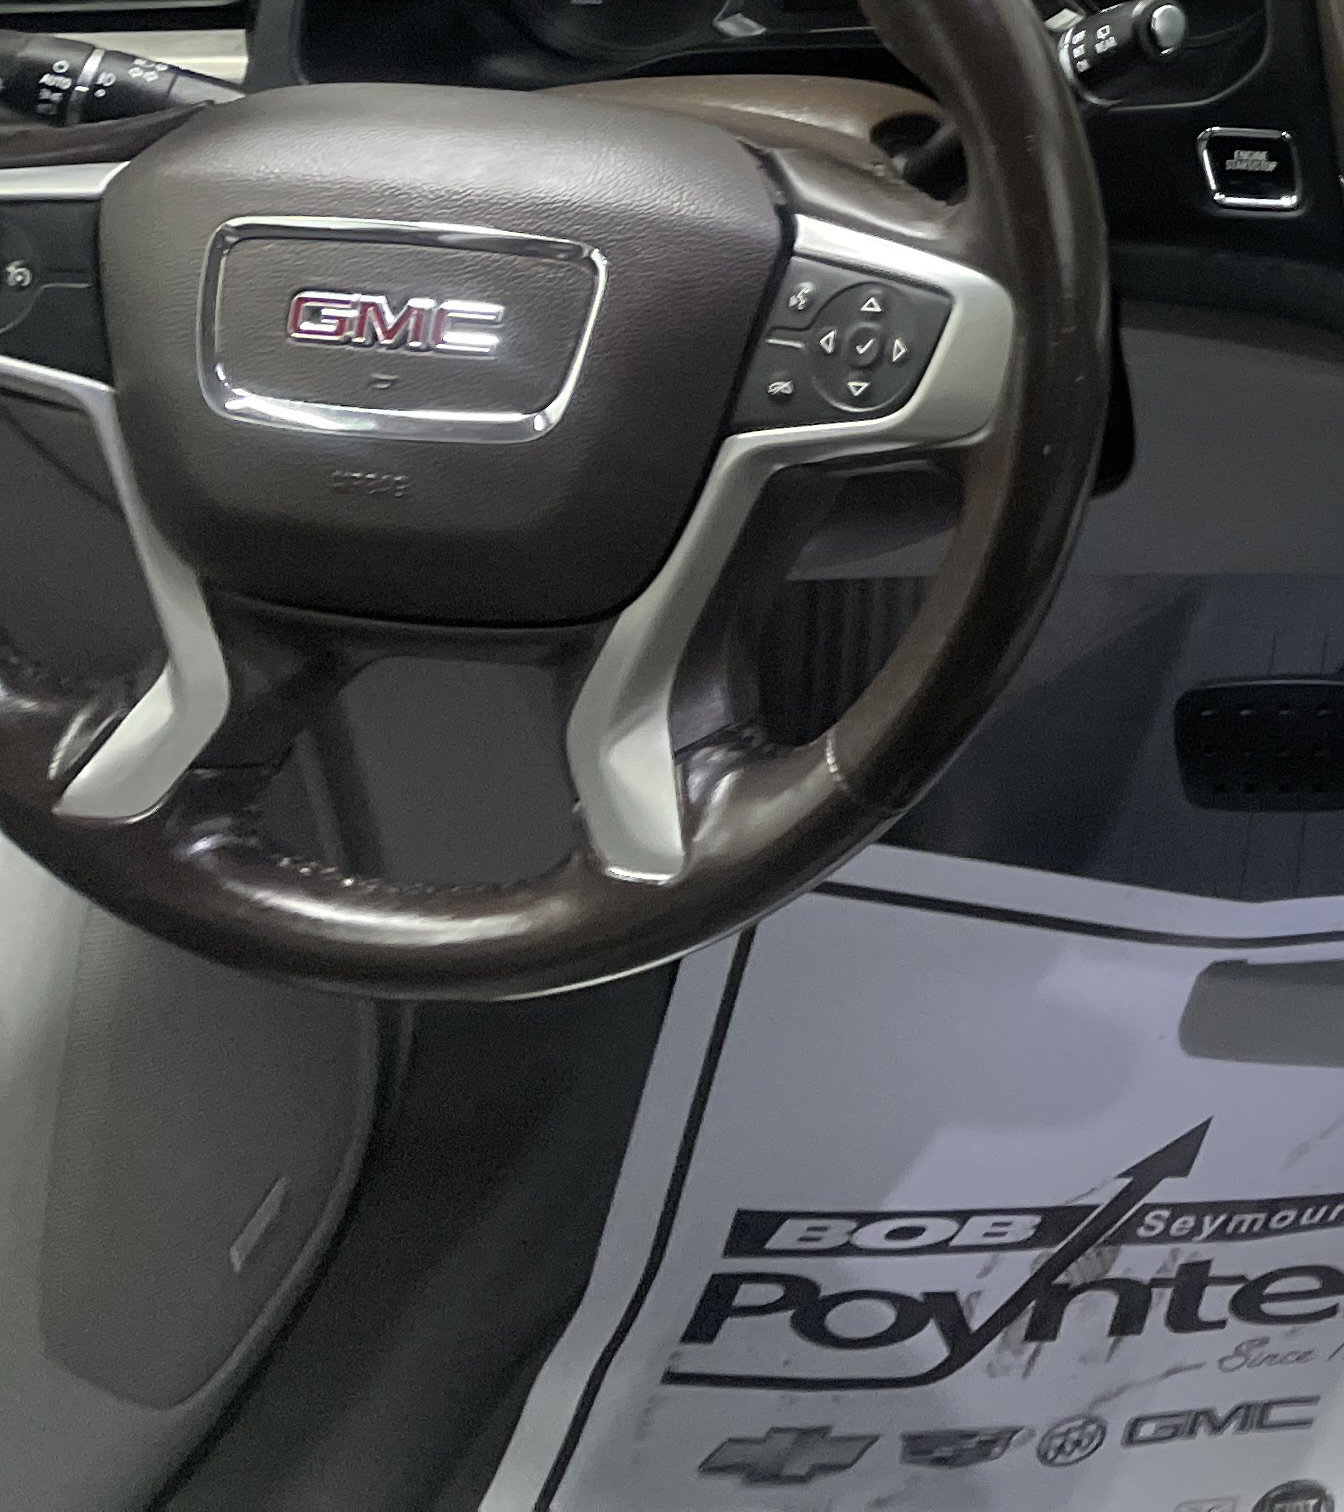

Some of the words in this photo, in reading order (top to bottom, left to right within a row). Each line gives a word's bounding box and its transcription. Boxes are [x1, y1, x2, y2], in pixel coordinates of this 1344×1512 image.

[287, 290, 505, 355] GMC
[764, 1214, 1042, 1251] BOB
[1217, 1335, 1316, 1374] Since
[1121, 1395, 1321, 1449] GMC
